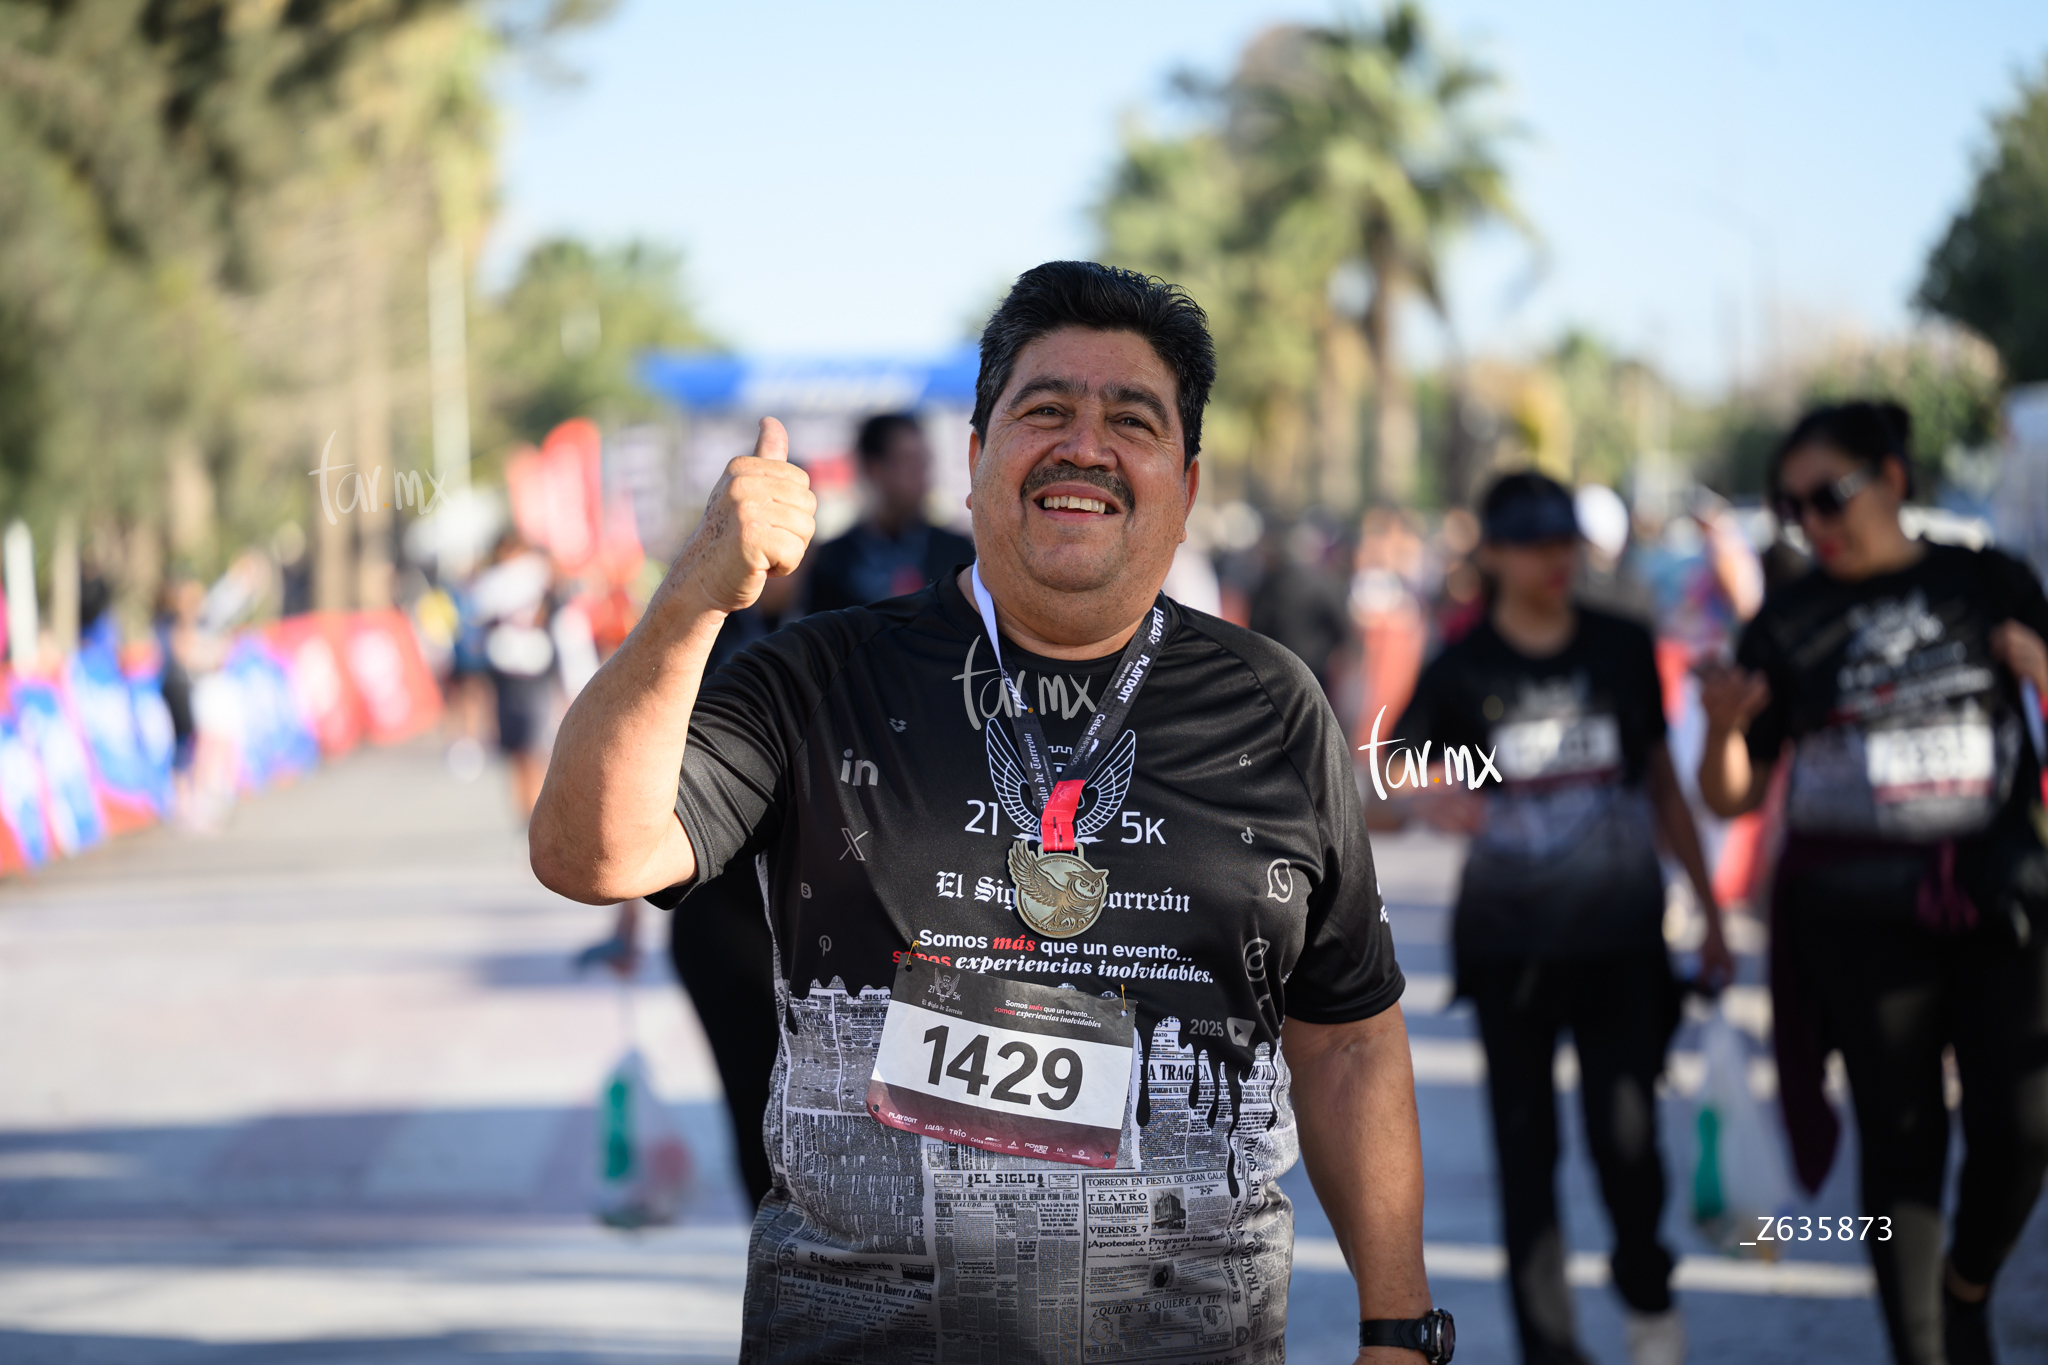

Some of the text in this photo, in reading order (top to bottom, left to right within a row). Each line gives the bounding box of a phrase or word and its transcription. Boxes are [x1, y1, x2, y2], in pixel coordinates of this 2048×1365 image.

[1117, 654, 1150, 703] PLAYDOIT
[1088, 714, 1106, 736] Celsa
[1024, 733, 1041, 770] Torreón
[1070, 735, 1092, 767] IMPRESOS
[840, 748, 879, 786] in
[1034, 772, 1046, 783] de
[964, 800, 1166, 844] 21 5K
[936, 870, 1190, 913] El Sig orreón
[919, 930, 1193, 962] Somos más que un evento...
[956, 953, 1093, 975] experiencias
[1098, 958, 1214, 984] inolvidables.
[994, 1006, 1102, 1028] somos experiencias inolvidables
[1005, 1000, 1028, 1010] Somos
[1028, 1003, 1043, 1012] más
[1044, 1006, 1056, 1014] que
[1189, 1019, 1224, 1038] 2025
[923, 1025, 1084, 1110] 1429
[888, 1112, 918, 1124] PLAYDOIT
[970, 1137, 984, 1145] Celsa
[1024, 1142, 1048, 1150] POWER
[1243, 1137, 1260, 1172] SIDAR
[974, 1174, 1036, 1184] EL SIGLO
[1087, 1178, 1128, 1186] TORREON
[1132, 1178, 1142, 1186] EN
[1146, 1176, 1172, 1185] FIESTA
[1186, 1174, 1206, 1182] GRAN
[1250, 1179, 1261, 1196] DE
[1087, 1193, 1147, 1202] TEATRO
[1088, 1204, 1148, 1214] ISAURO MARTINEZ
[1089, 1226, 1137, 1234] VIERNES
[1149, 1236, 1190, 1246] Programa
[810, 1252, 894, 1272] El Siglo de Torreón
[1240, 1241, 1260, 1294] TRAGICO
[793, 1268, 818, 1282] Estados
[820, 1272, 842, 1286] Unidos
[845, 1279, 874, 1292] Declaran
[876, 1282, 882, 1292] la
[884, 1284, 906, 1298] Guerra
[913, 1288, 932, 1301] China
[1092, 1294, 1221, 1318] ¿QUIEN TE QUIERE A TI?
[1252, 1300, 1261, 1316] EL
